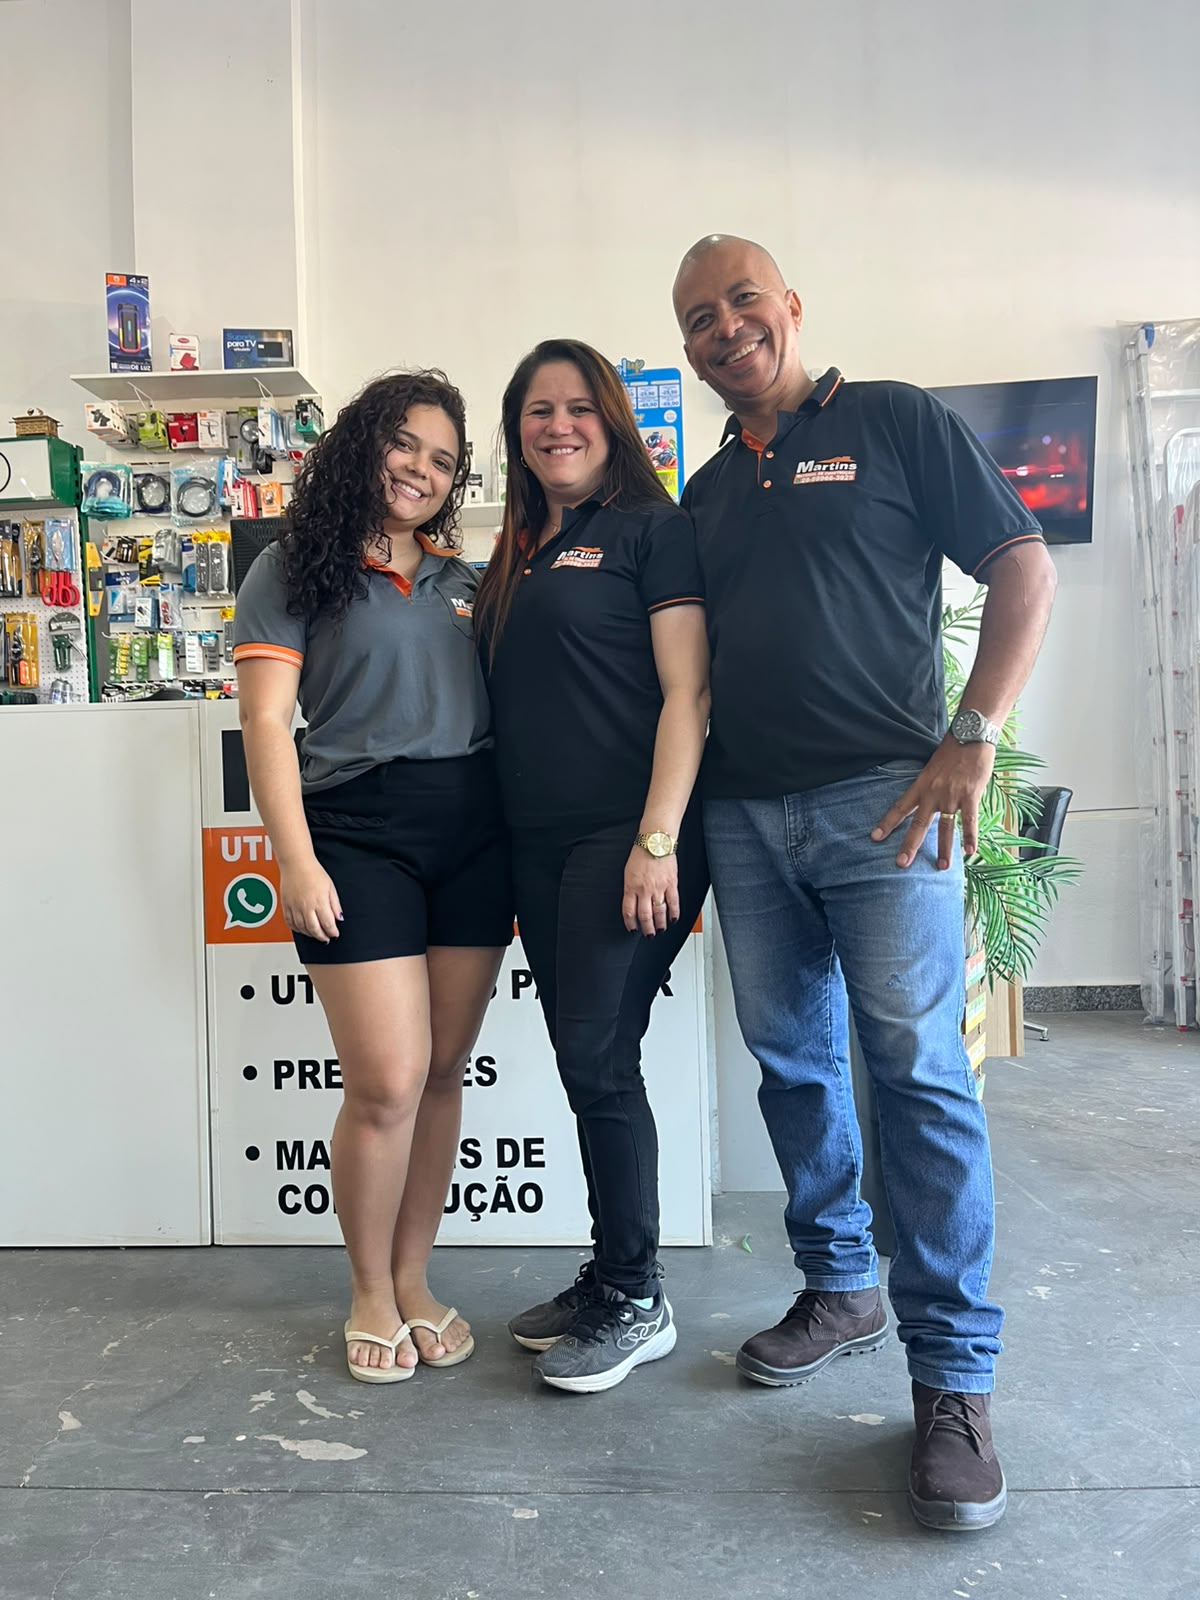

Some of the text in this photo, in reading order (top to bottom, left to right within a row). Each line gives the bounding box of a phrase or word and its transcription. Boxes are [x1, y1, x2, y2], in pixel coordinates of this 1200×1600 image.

[244, 340, 257, 348] TV
[796, 460, 857, 474] Martins
[496, 1137, 546, 1168] DE
